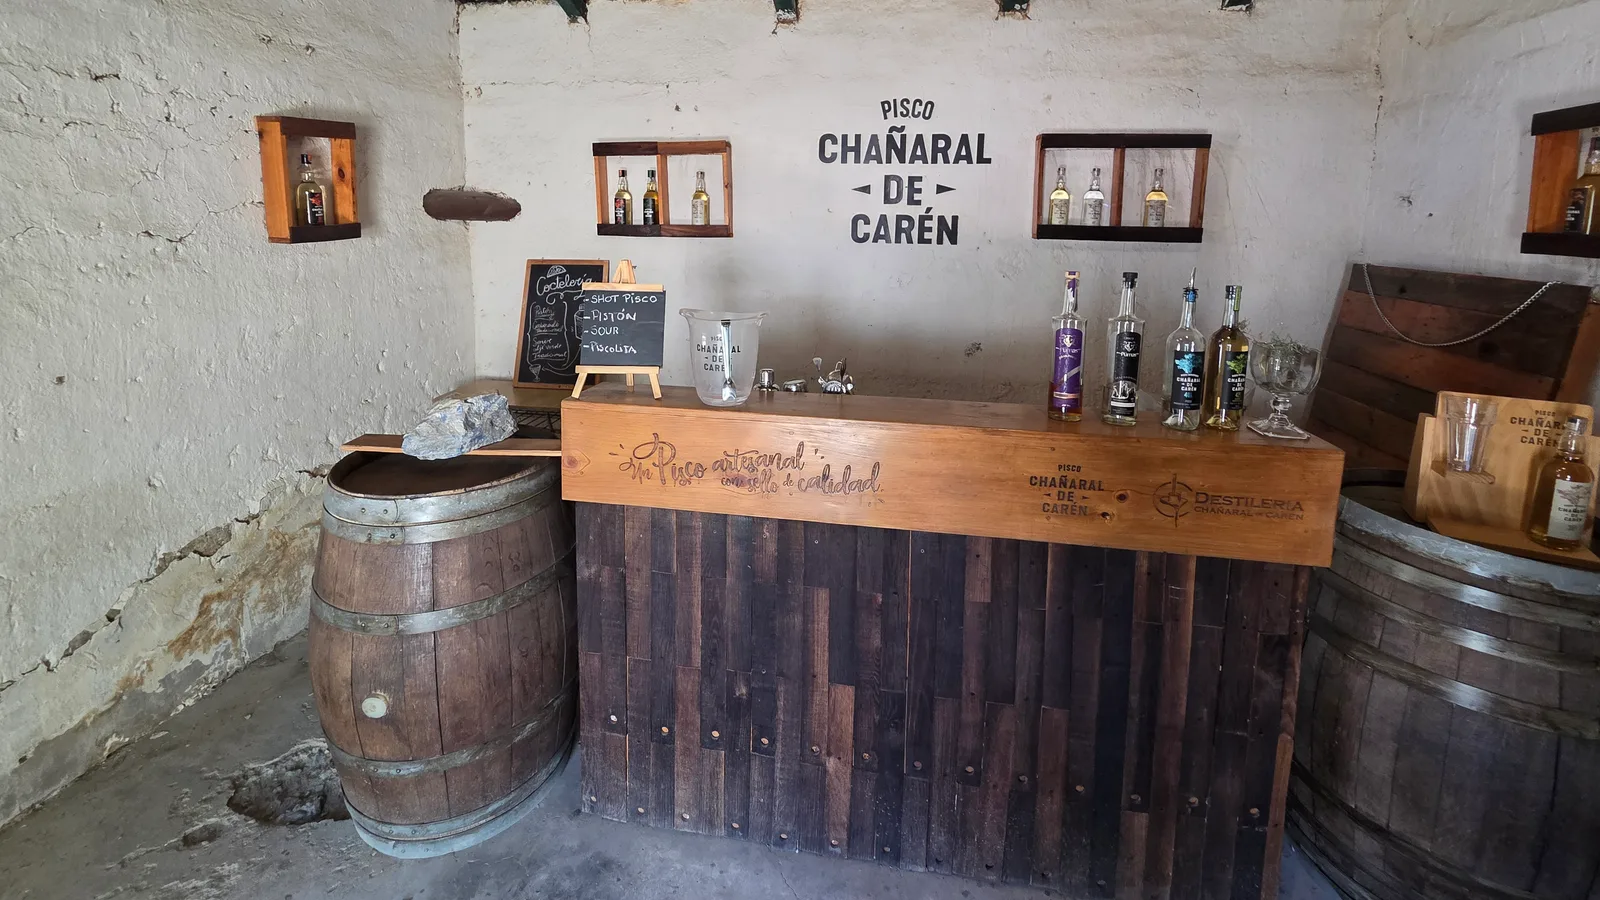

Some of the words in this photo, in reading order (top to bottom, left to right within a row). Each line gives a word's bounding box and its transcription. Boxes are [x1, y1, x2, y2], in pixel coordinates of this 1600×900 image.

[880, 98, 935, 120] PISCO
[818, 125, 992, 165] CHAÑARAL
[883, 174, 923, 206] DE
[851, 206, 959, 245] CARÉN
[696, 343, 742, 354] CHAÑAAL
[1534, 428, 1549, 437] DE
[633, 433, 707, 487] Pisco
[711, 441, 806, 473] artesanal
[1058, 464, 1082, 473] PISCO
[748, 469, 780, 493] sello
[783, 473, 795, 488] de
[1029, 475, 1105, 492] CHAÑARAL
[1057, 490, 1075, 502] DE
[1042, 502, 1089, 516] CARÉN
